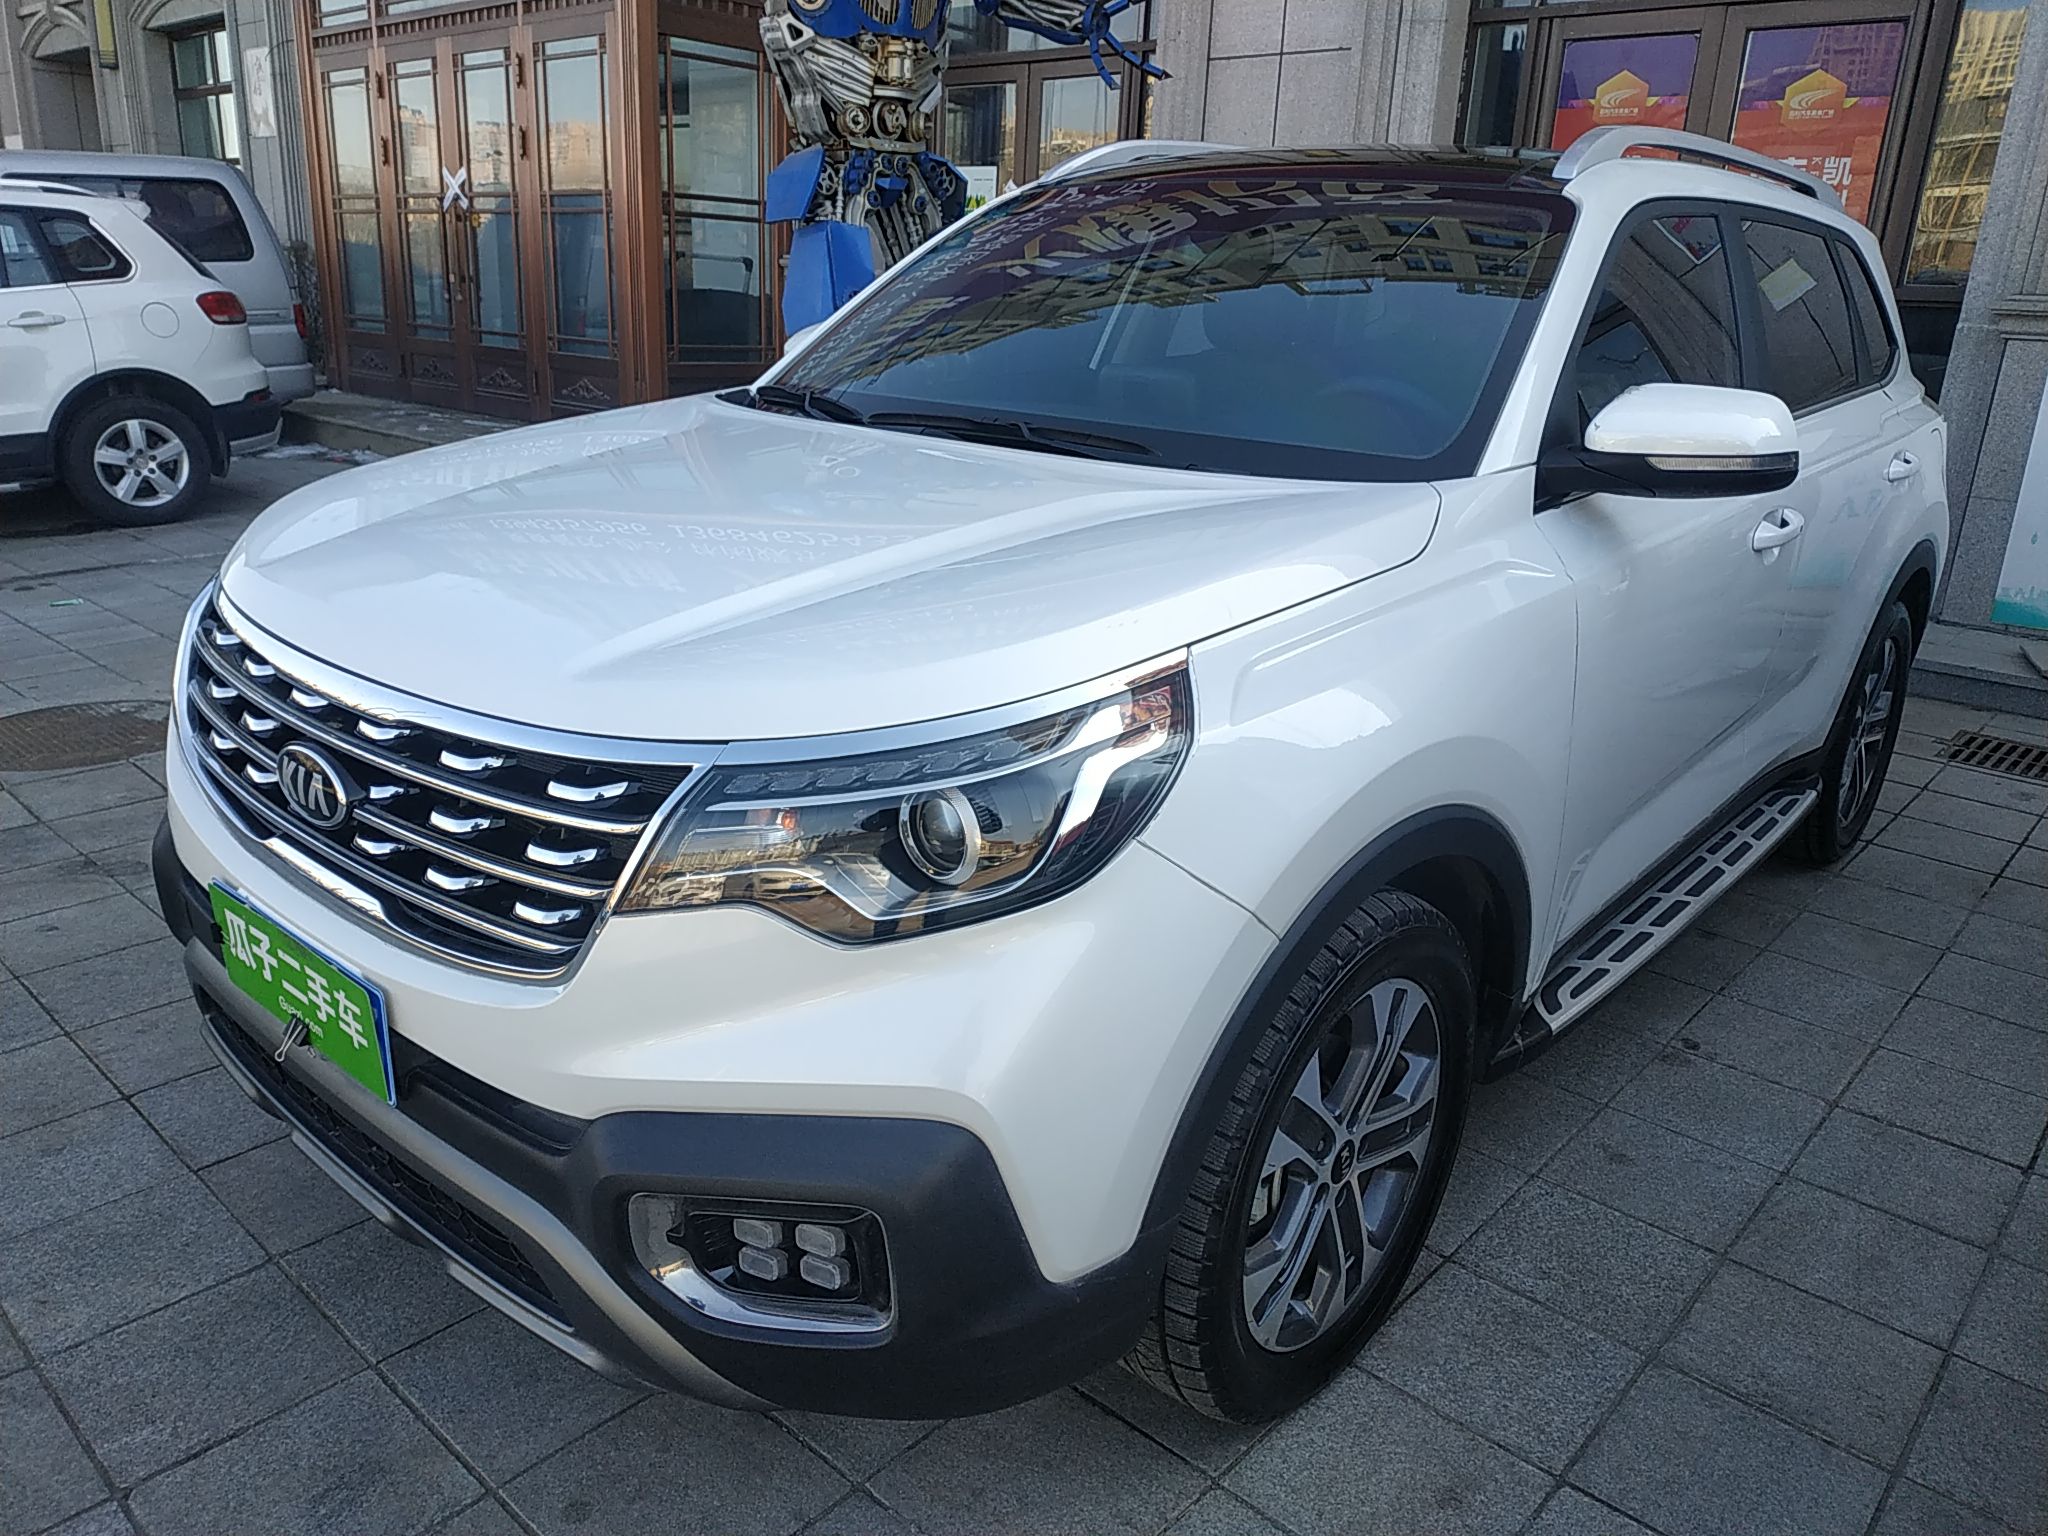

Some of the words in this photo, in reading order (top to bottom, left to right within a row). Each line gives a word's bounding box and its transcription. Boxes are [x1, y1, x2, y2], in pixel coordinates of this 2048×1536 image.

[224, 908, 368, 1049] 瓜子二手车
